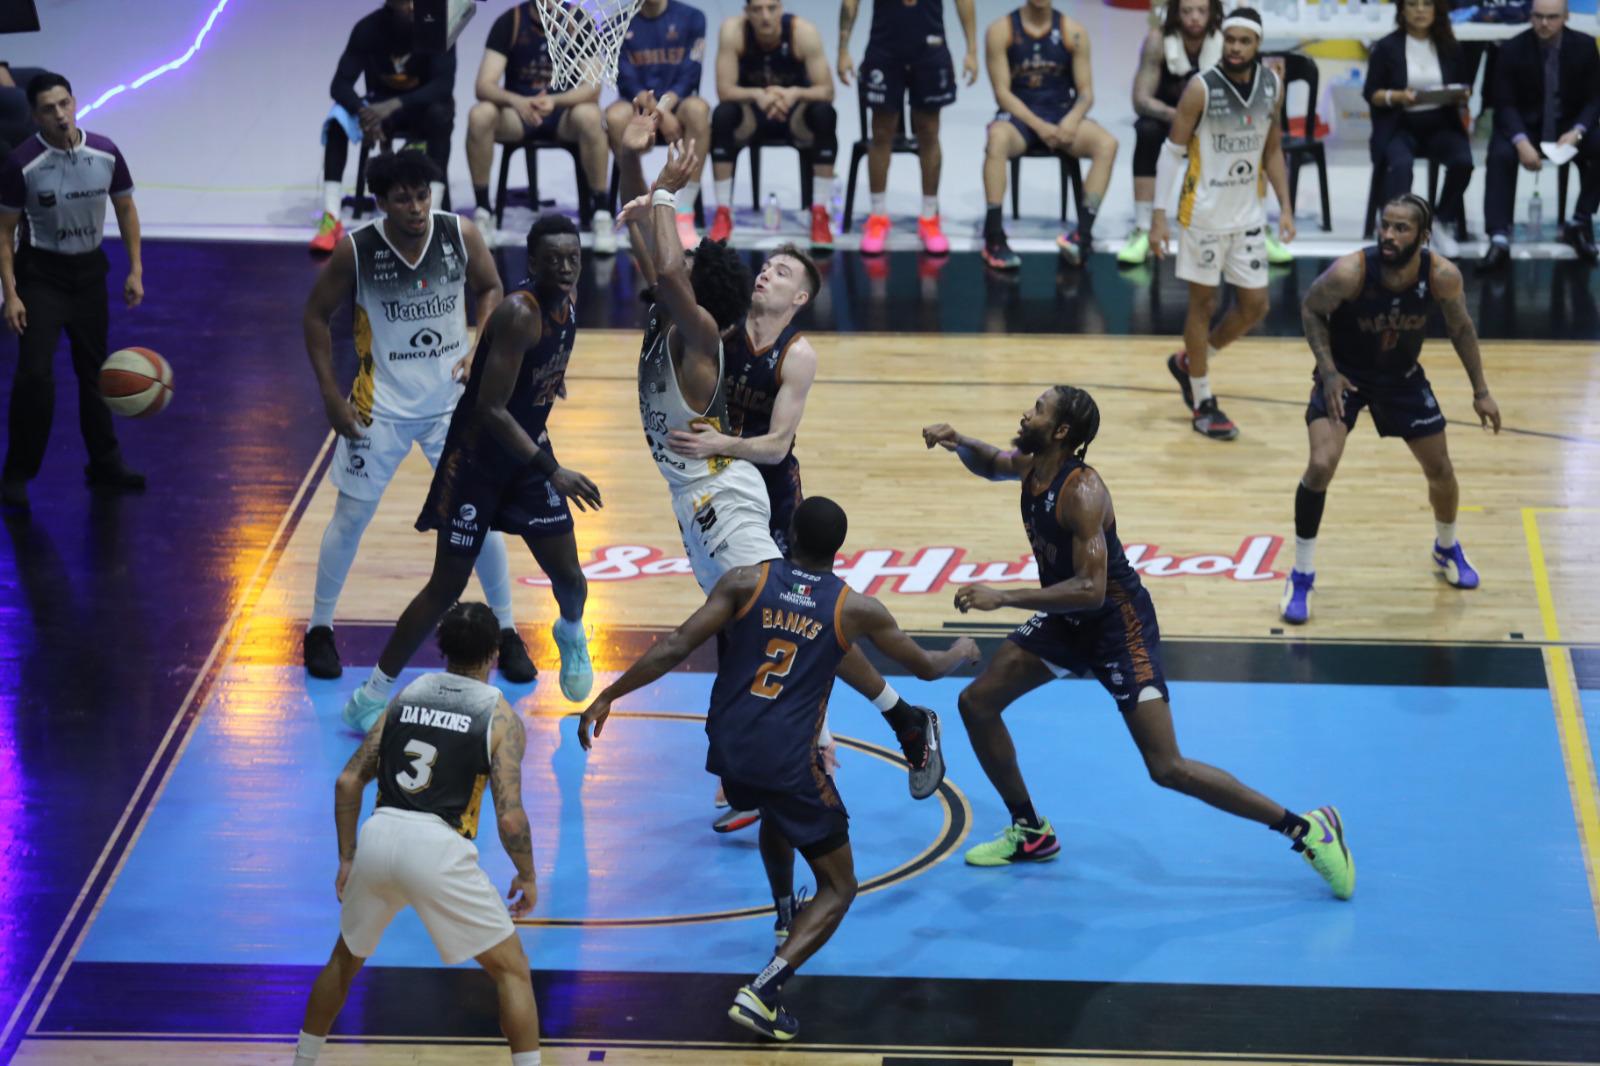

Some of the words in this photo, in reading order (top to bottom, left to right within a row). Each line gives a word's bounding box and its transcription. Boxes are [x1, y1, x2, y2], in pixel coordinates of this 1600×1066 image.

[389, 351, 427, 361] Banco
[451, 517, 478, 532] MEGA
[762, 607, 823, 640] BANKS
[750, 638, 798, 700] 2
[399, 705, 472, 733] DAWKINS
[395, 738, 438, 794] 3
